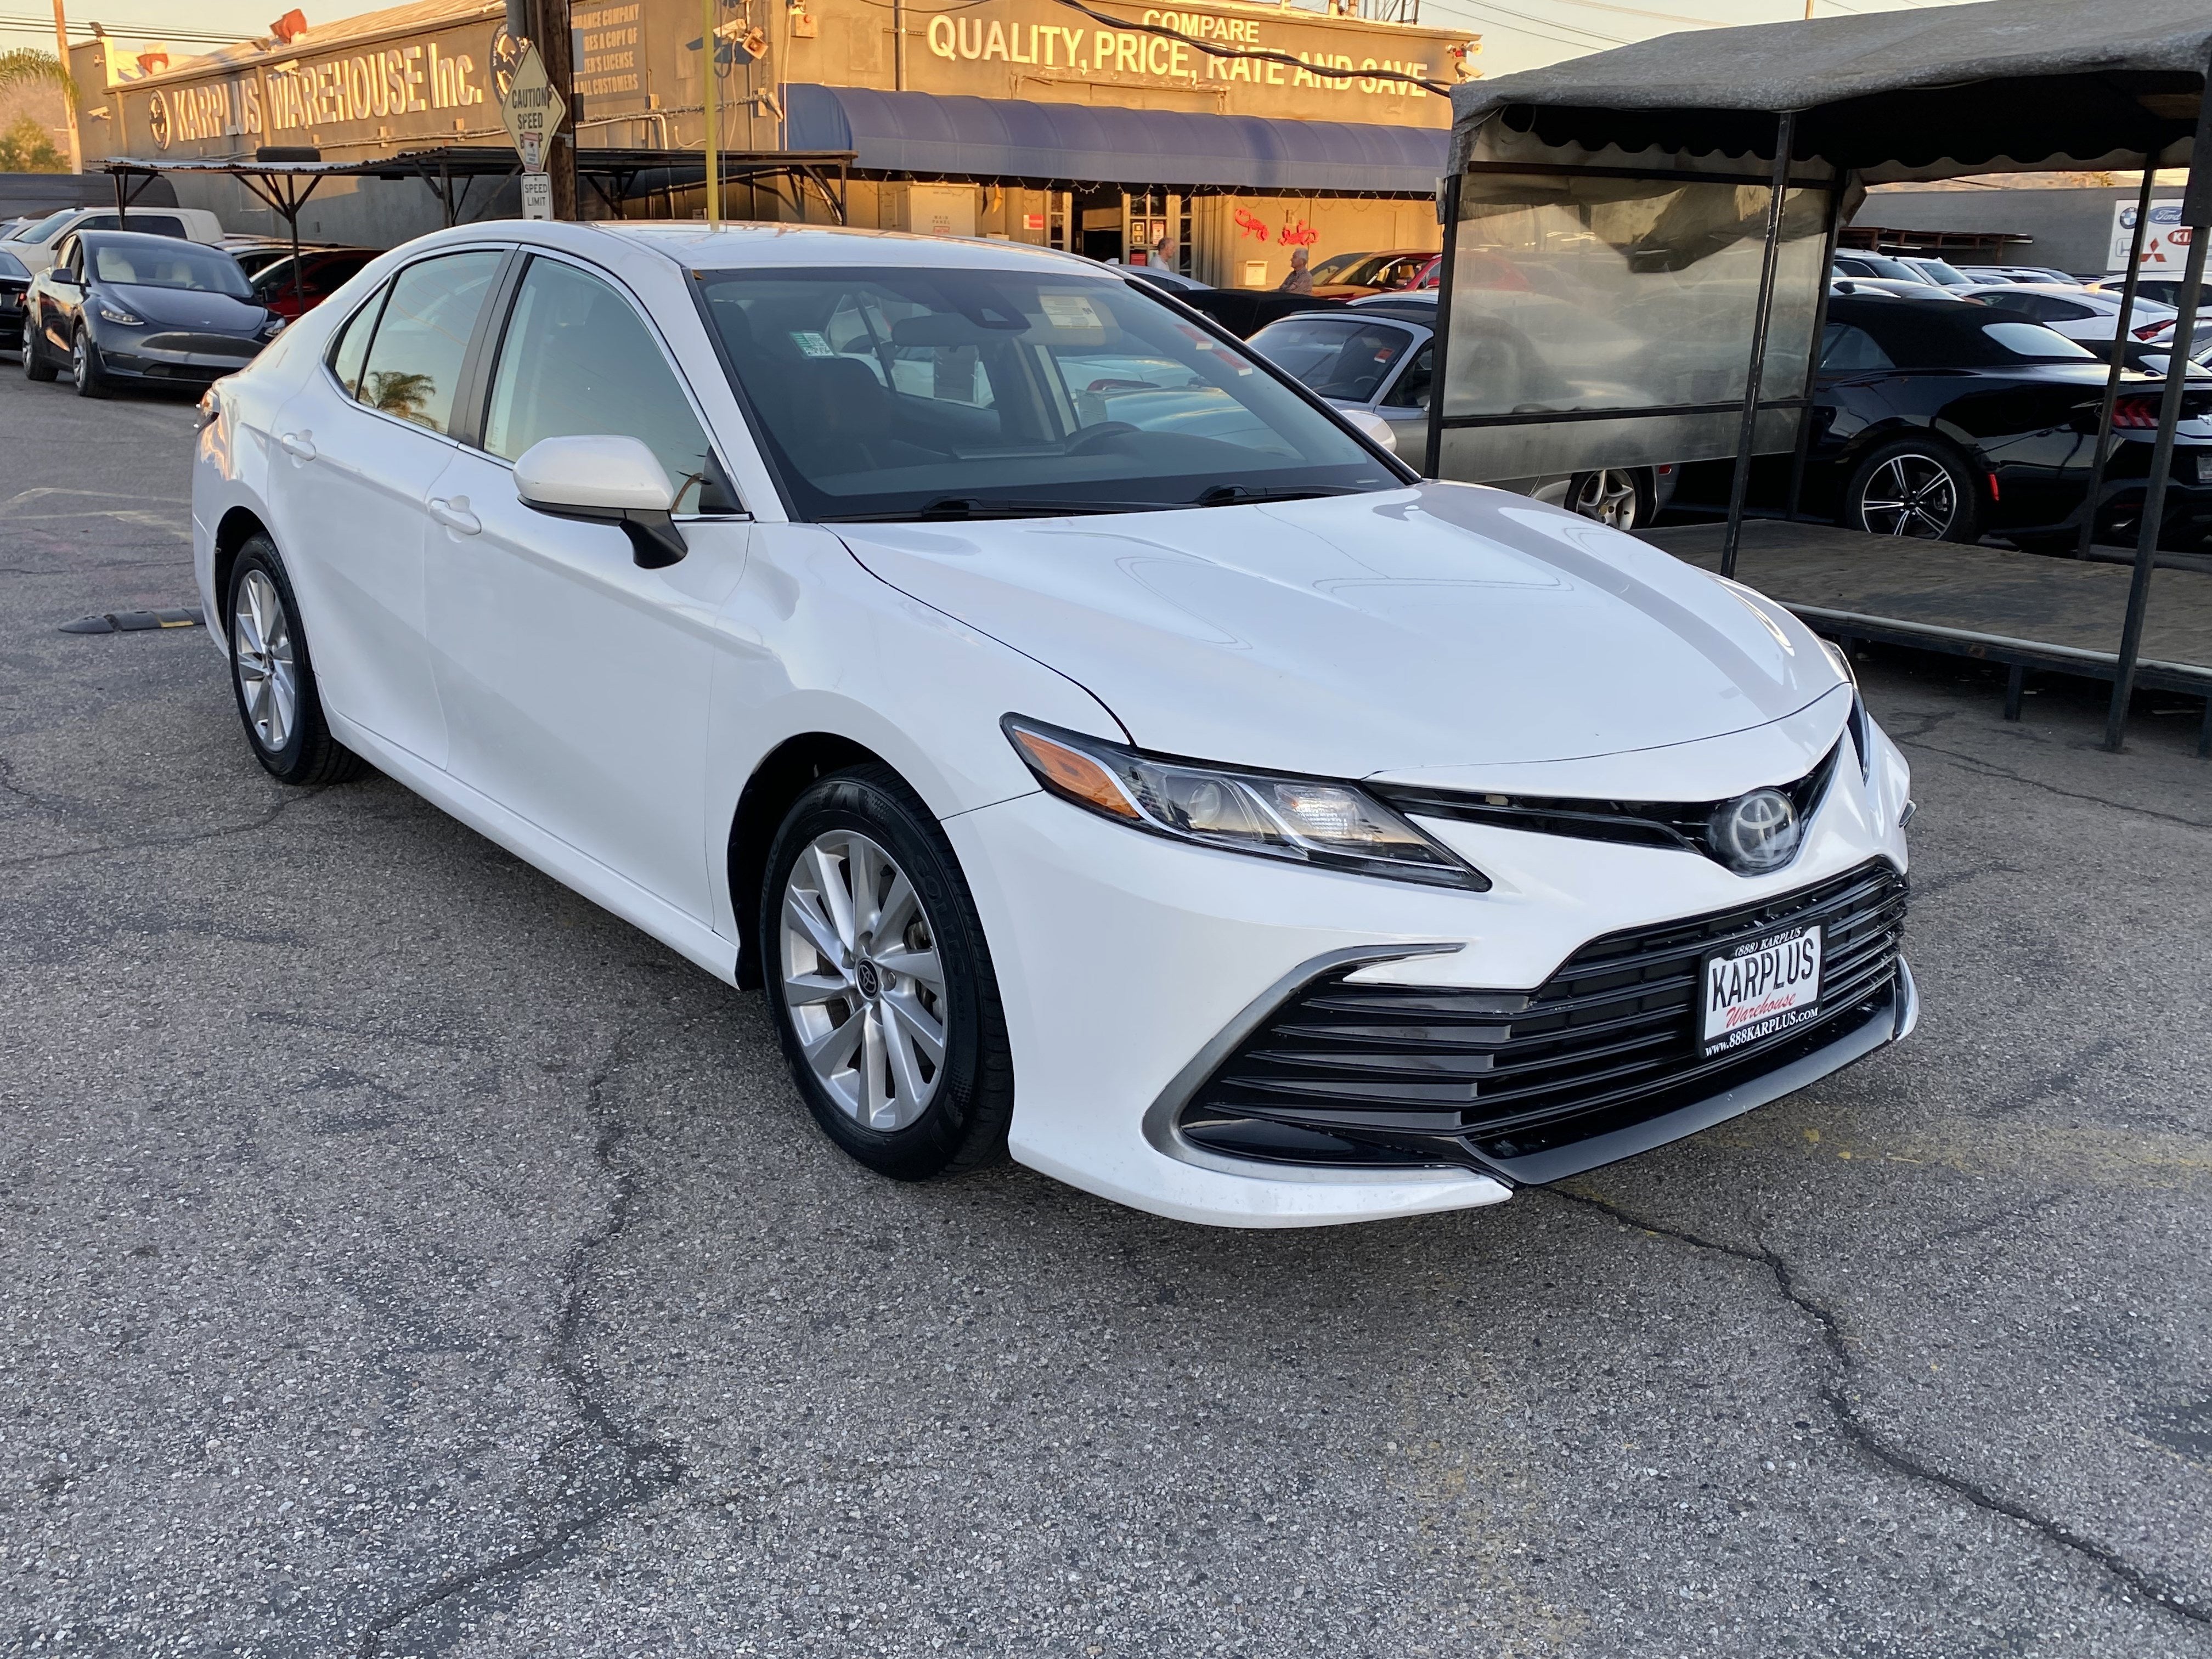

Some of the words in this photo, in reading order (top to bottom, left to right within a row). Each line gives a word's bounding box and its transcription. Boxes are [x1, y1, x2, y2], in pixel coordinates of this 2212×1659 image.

[571, 11, 601, 30] URANCE
[602, 3, 639, 26] COMPANY
[1142, 9, 1260, 43] COMPARE
[599, 33, 606, 49] A
[606, 29, 627, 48] COPY
[627, 27, 637, 44] OF
[603, 50, 634, 71] LICENSE
[927, 14, 1087, 75] QUALITY,
[1094, 31, 1198, 86] PRICE,
[1206, 42, 1285, 85] RATE
[1292, 52, 1353, 90] AND
[1359, 58, 1427, 97] SAVE
[172, 77, 262, 142] KARPLUS
[266, 46, 426, 129] WAREHOUSE
[427, 42, 483, 109] Inc.
[592, 73, 639, 95] CUSTOMERS
[512, 87, 548, 109] CAUTION
[517, 112, 543, 130] SPEED
[520, 132, 543, 149] BP
[524, 184, 548, 193] SPEED
[527, 196, 546, 206] LIMIT
[2155, 210, 2182, 221] Ford
[2173, 232, 2191, 242] KI
[1735, 941, 1759, 957] (888)
[1760, 926, 1802, 950] KARPLUS
[1712, 938, 1814, 1012] KARPLUS
[1725, 992, 1796, 1029] Warehouse
